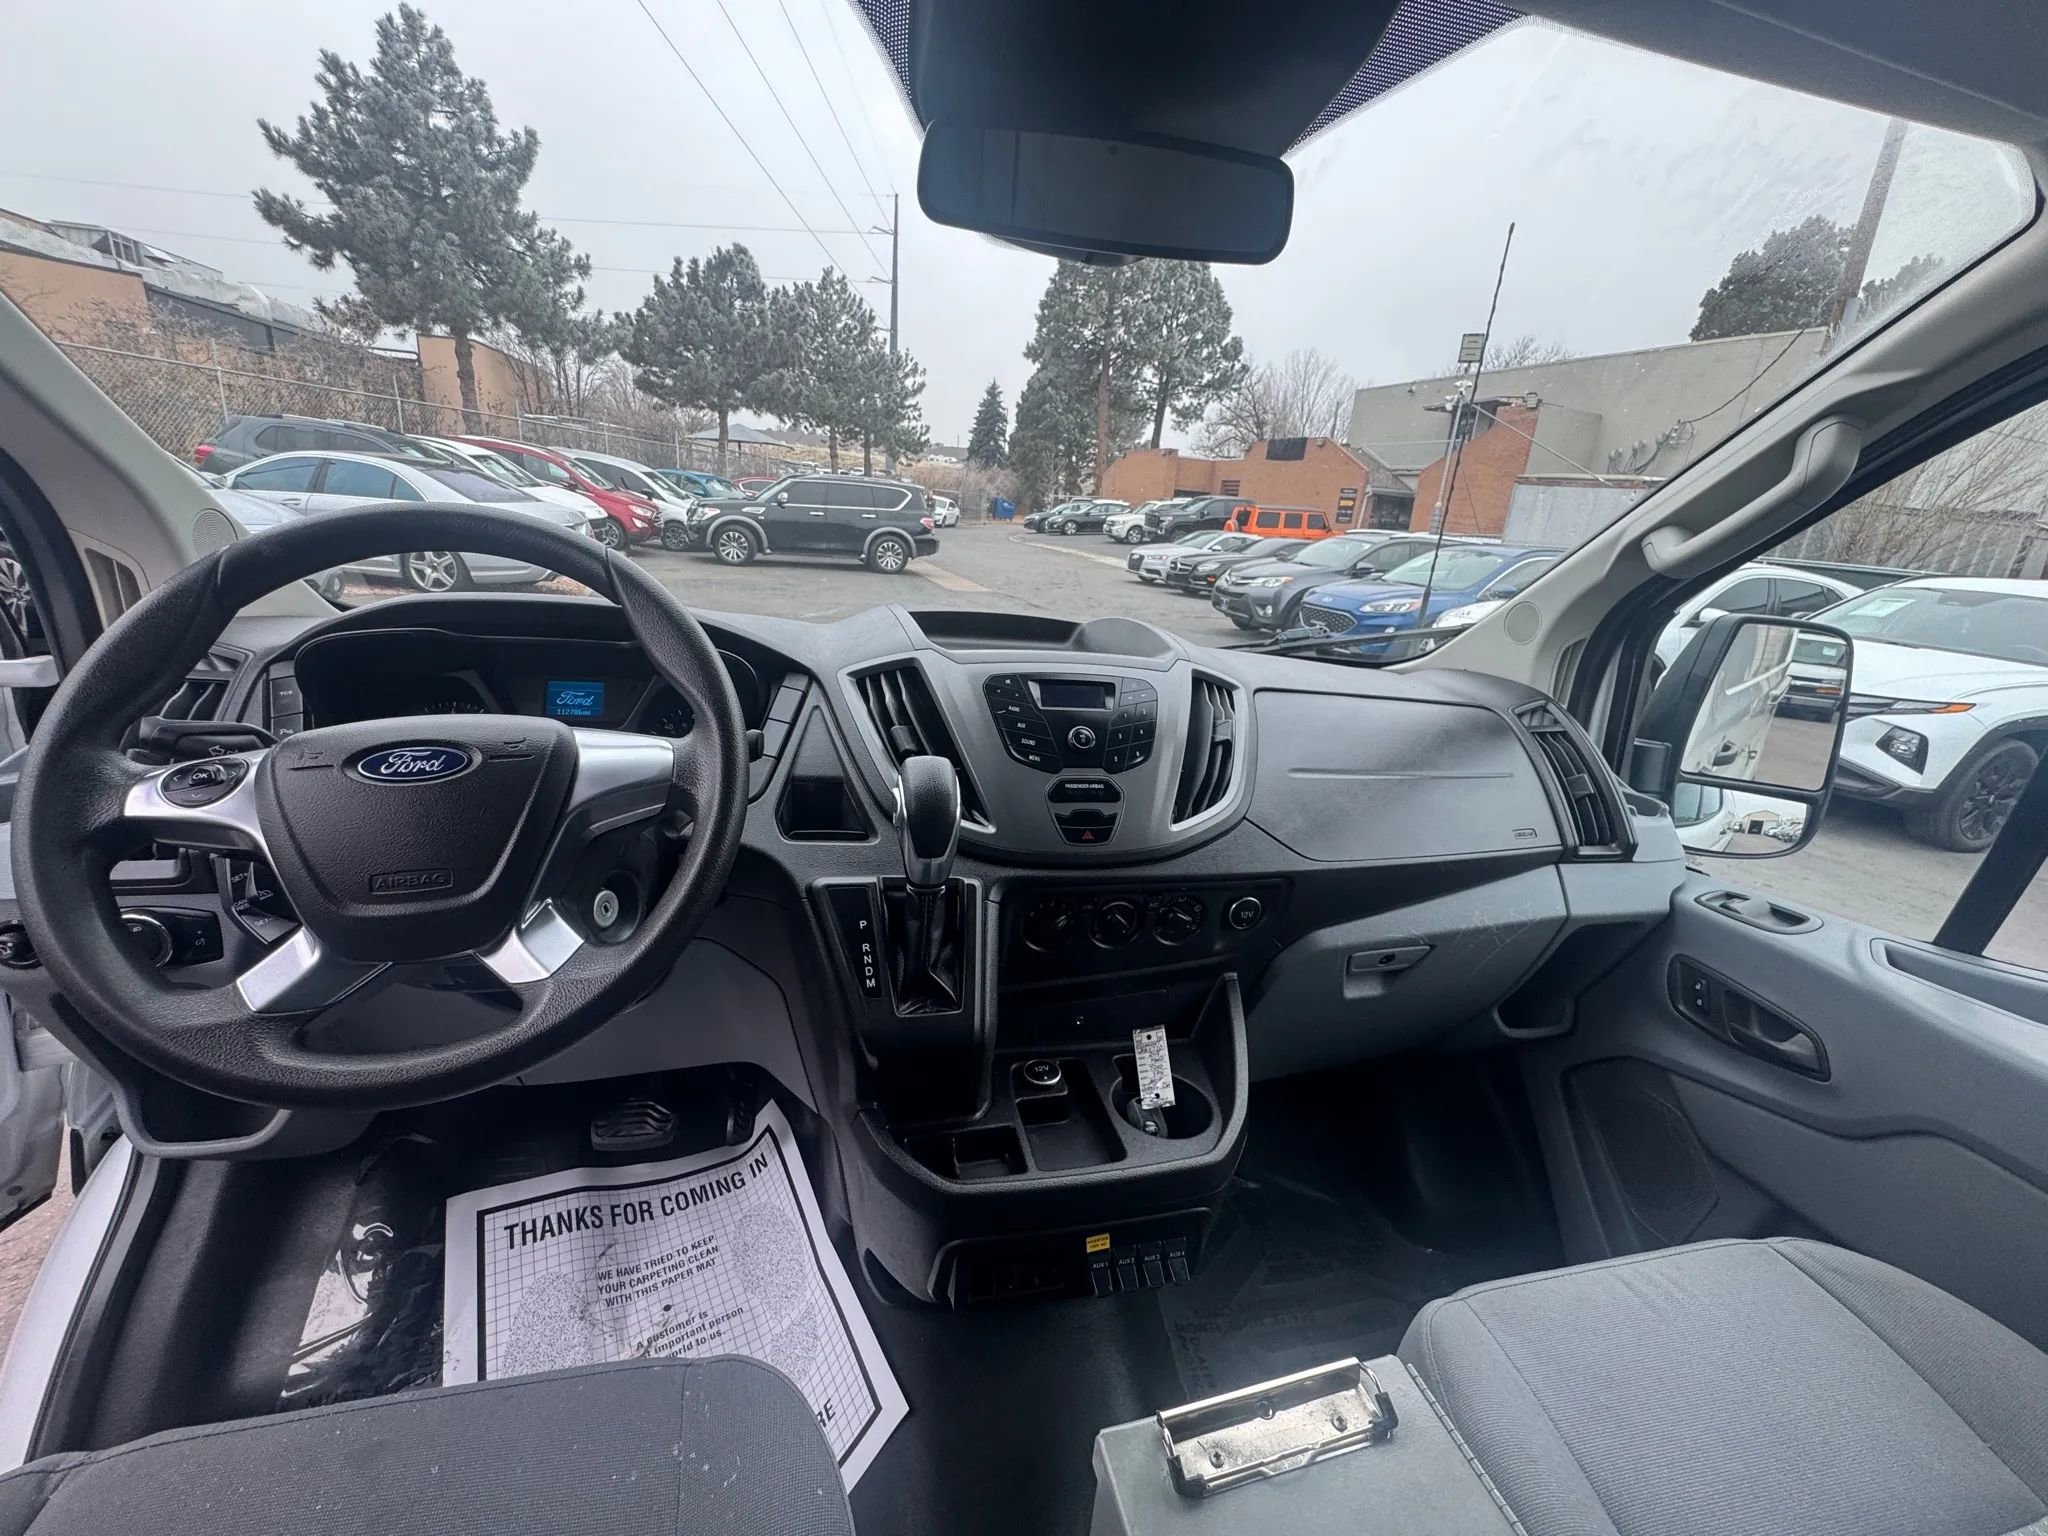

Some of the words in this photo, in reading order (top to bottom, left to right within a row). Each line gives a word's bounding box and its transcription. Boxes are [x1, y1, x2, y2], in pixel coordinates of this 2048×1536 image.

[556, 690, 595, 706] Ford
[380, 751, 446, 774] Ford
[192, 772, 209, 780] OK
[375, 873, 445, 890] AIRBAG
[859, 920, 867, 929] P
[862, 943, 871, 952] R
[864, 955, 872, 964] N
[865, 966, 873, 976] D
[866, 978, 876, 988] M
[504, 1205, 604, 1250] THANKS
[610, 1200, 654, 1227] FOR
[660, 1171, 746, 1217] COMING
[749, 1152, 769, 1178] IN
[598, 1269, 614, 1282] WE
[616, 1264, 641, 1278] HAVE
[643, 1252, 673, 1270] TRIED
[675, 1246, 689, 1257] TO
[691, 1235, 715, 1251] KEEP
[598, 1282, 626, 1295] YOUR
[629, 1260, 686, 1289] CARPETING
[688, 1245, 719, 1264] CLEAN
[605, 1293, 632, 1307] WITH
[635, 1283, 659, 1299] THIS
[661, 1268, 694, 1288] PAPER
[695, 1258, 717, 1273] MAT
[646, 1316, 696, 1345] customer
[698, 1310, 709, 1320] is
[654, 1323, 707, 1354] important
[708, 1307, 744, 1329] person
[695, 1337, 707, 1346] to
